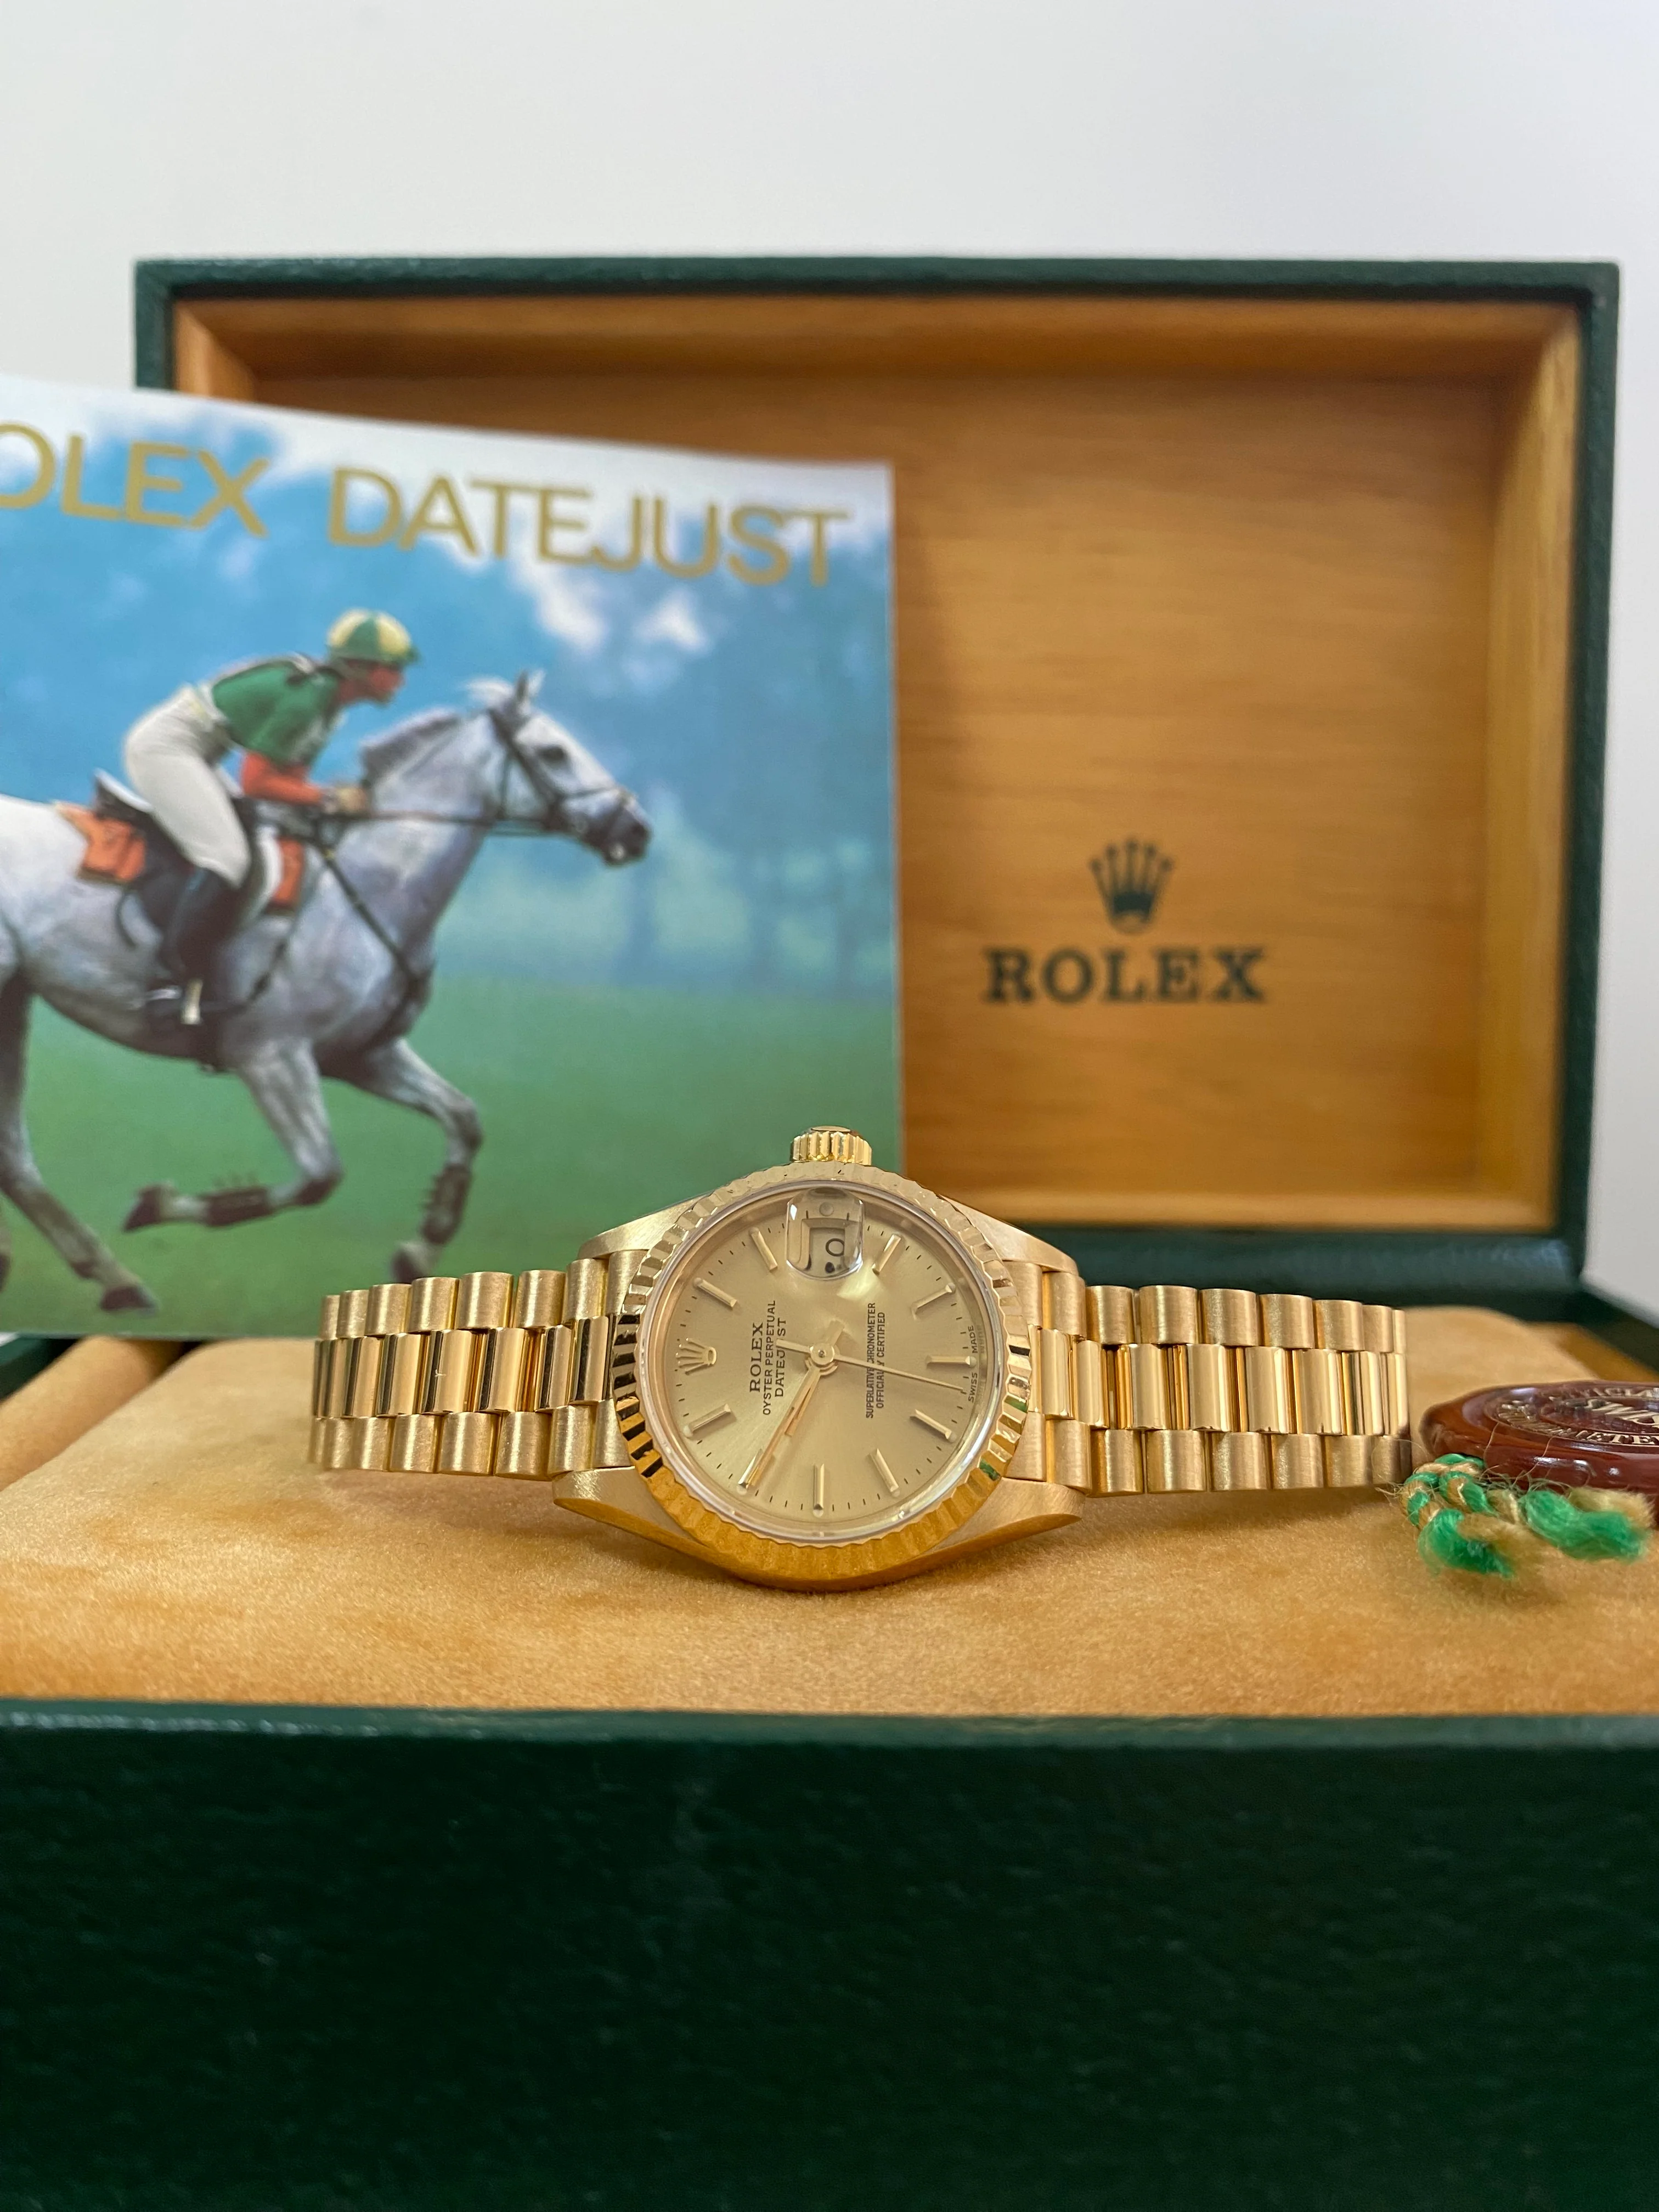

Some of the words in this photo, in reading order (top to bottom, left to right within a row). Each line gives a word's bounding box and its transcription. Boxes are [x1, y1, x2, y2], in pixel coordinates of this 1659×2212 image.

[326, 466, 850, 587] DATEJUST
[984, 945, 1266, 1004] ROLEX
[749, 1322, 763, 1392] ROLEX
[765, 1300, 776, 1365] PERPETUAL
[775, 1317, 786, 1397] DATEJST
[877, 1312, 885, 1358] CERTIFIED
[968, 1325, 978, 1353] MADE
[763, 1369, 772, 1415] OYSTER
[876, 1361, 885, 1409] OFFICIALY
[968, 1372, 978, 1403] SWISS
